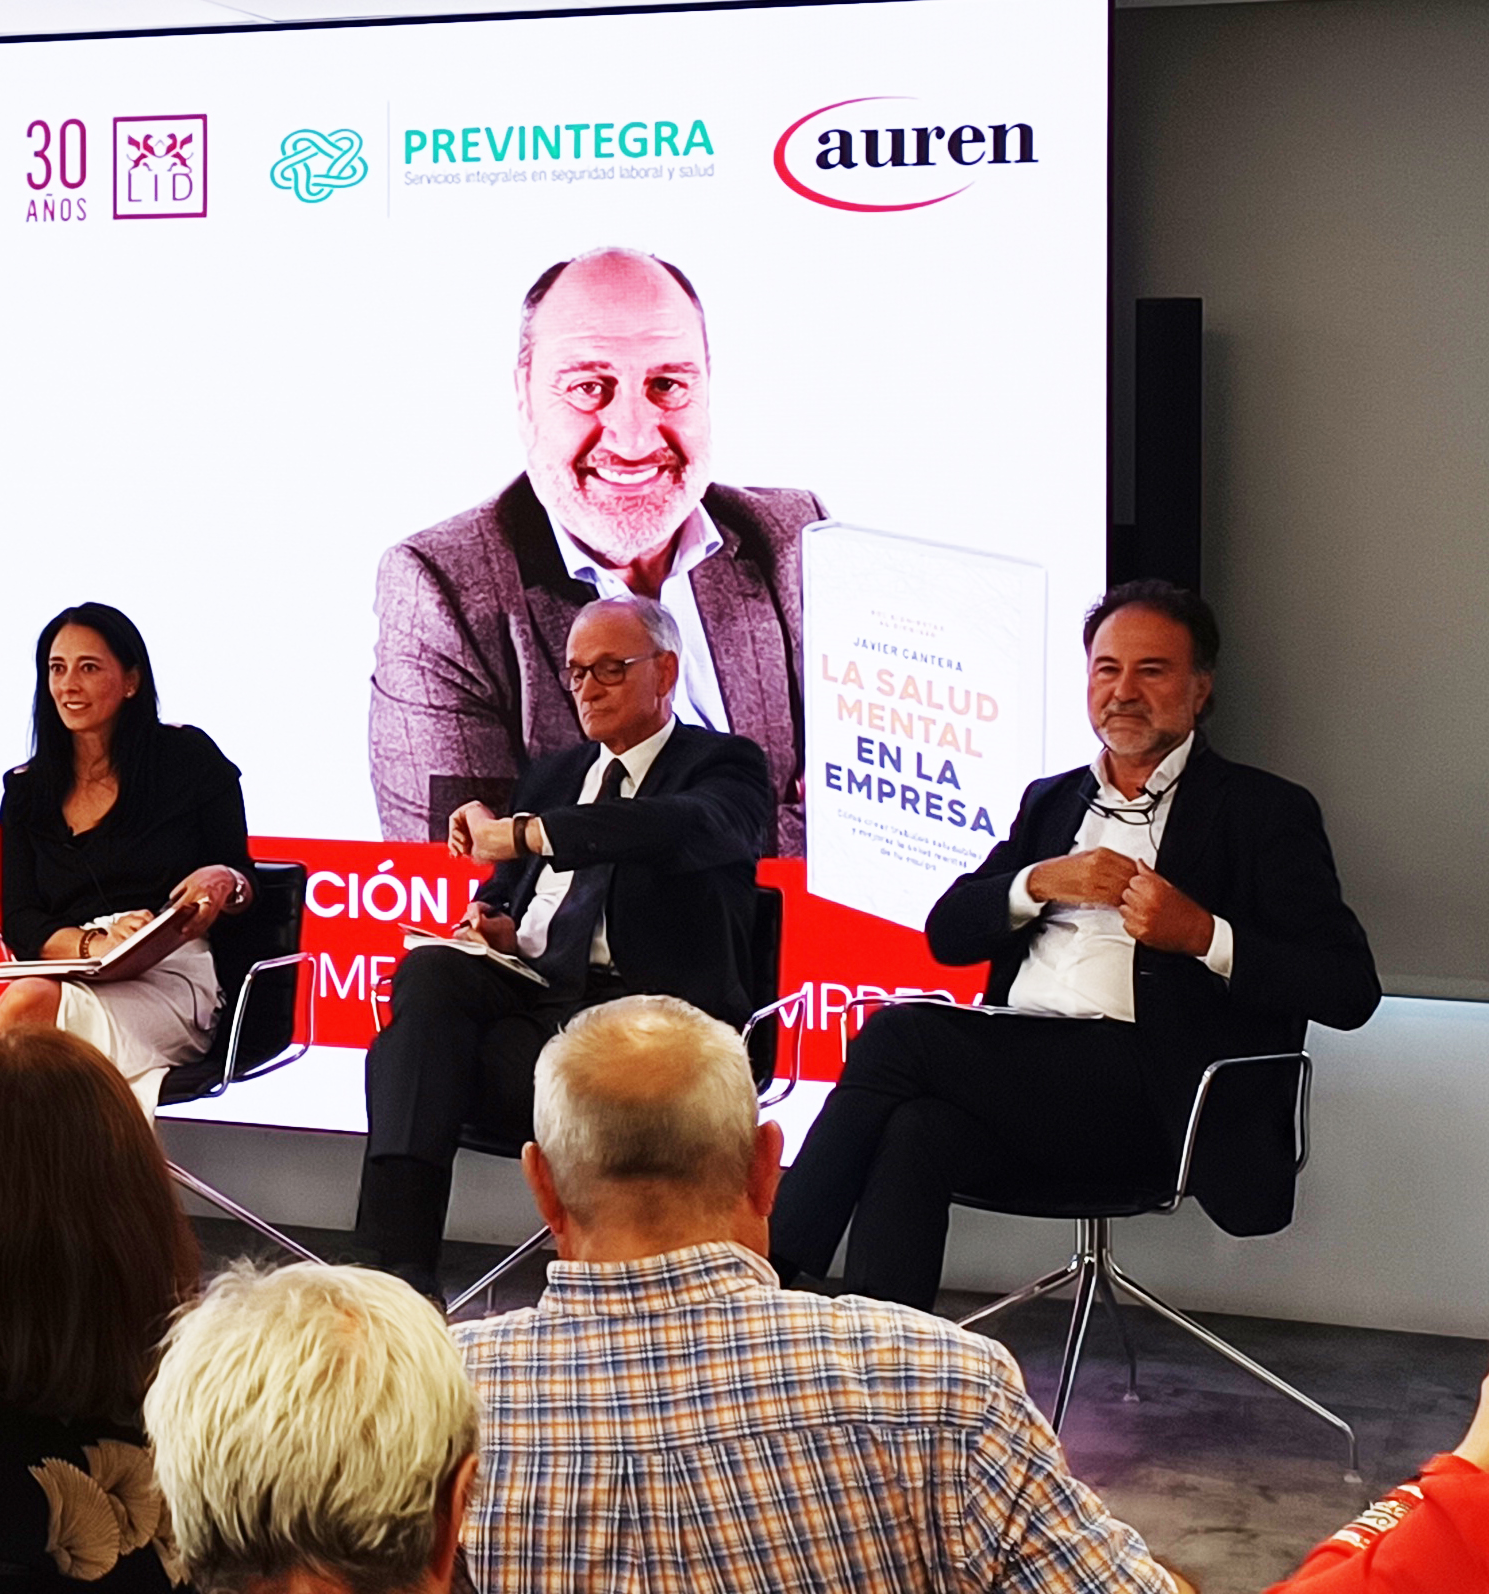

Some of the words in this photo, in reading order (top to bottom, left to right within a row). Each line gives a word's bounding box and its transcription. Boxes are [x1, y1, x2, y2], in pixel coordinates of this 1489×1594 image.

[26, 118, 87, 190] 30
[404, 120, 715, 164] PREVINTEGRA
[815, 122, 1039, 170] auren
[127, 171, 193, 202] LID
[404, 170, 461, 186] Servicios
[465, 168, 527, 186] integrales
[531, 171, 547, 182] en
[552, 166, 615, 184] seguridad
[619, 165, 663, 179] laboral
[666, 168, 675, 181] y
[679, 163, 715, 178] salud
[26, 193, 87, 223] AÑOS
[853, 637, 898, 656] JAVIER
[902, 648, 963, 672] CANTERA
[822, 654, 865, 690] LA
[876, 668, 999, 722] SALUD
[837, 694, 983, 758] MENTAL
[857, 735, 902, 773] EN
[916, 752, 962, 790] LA
[826, 762, 996, 838] EMPRESA
